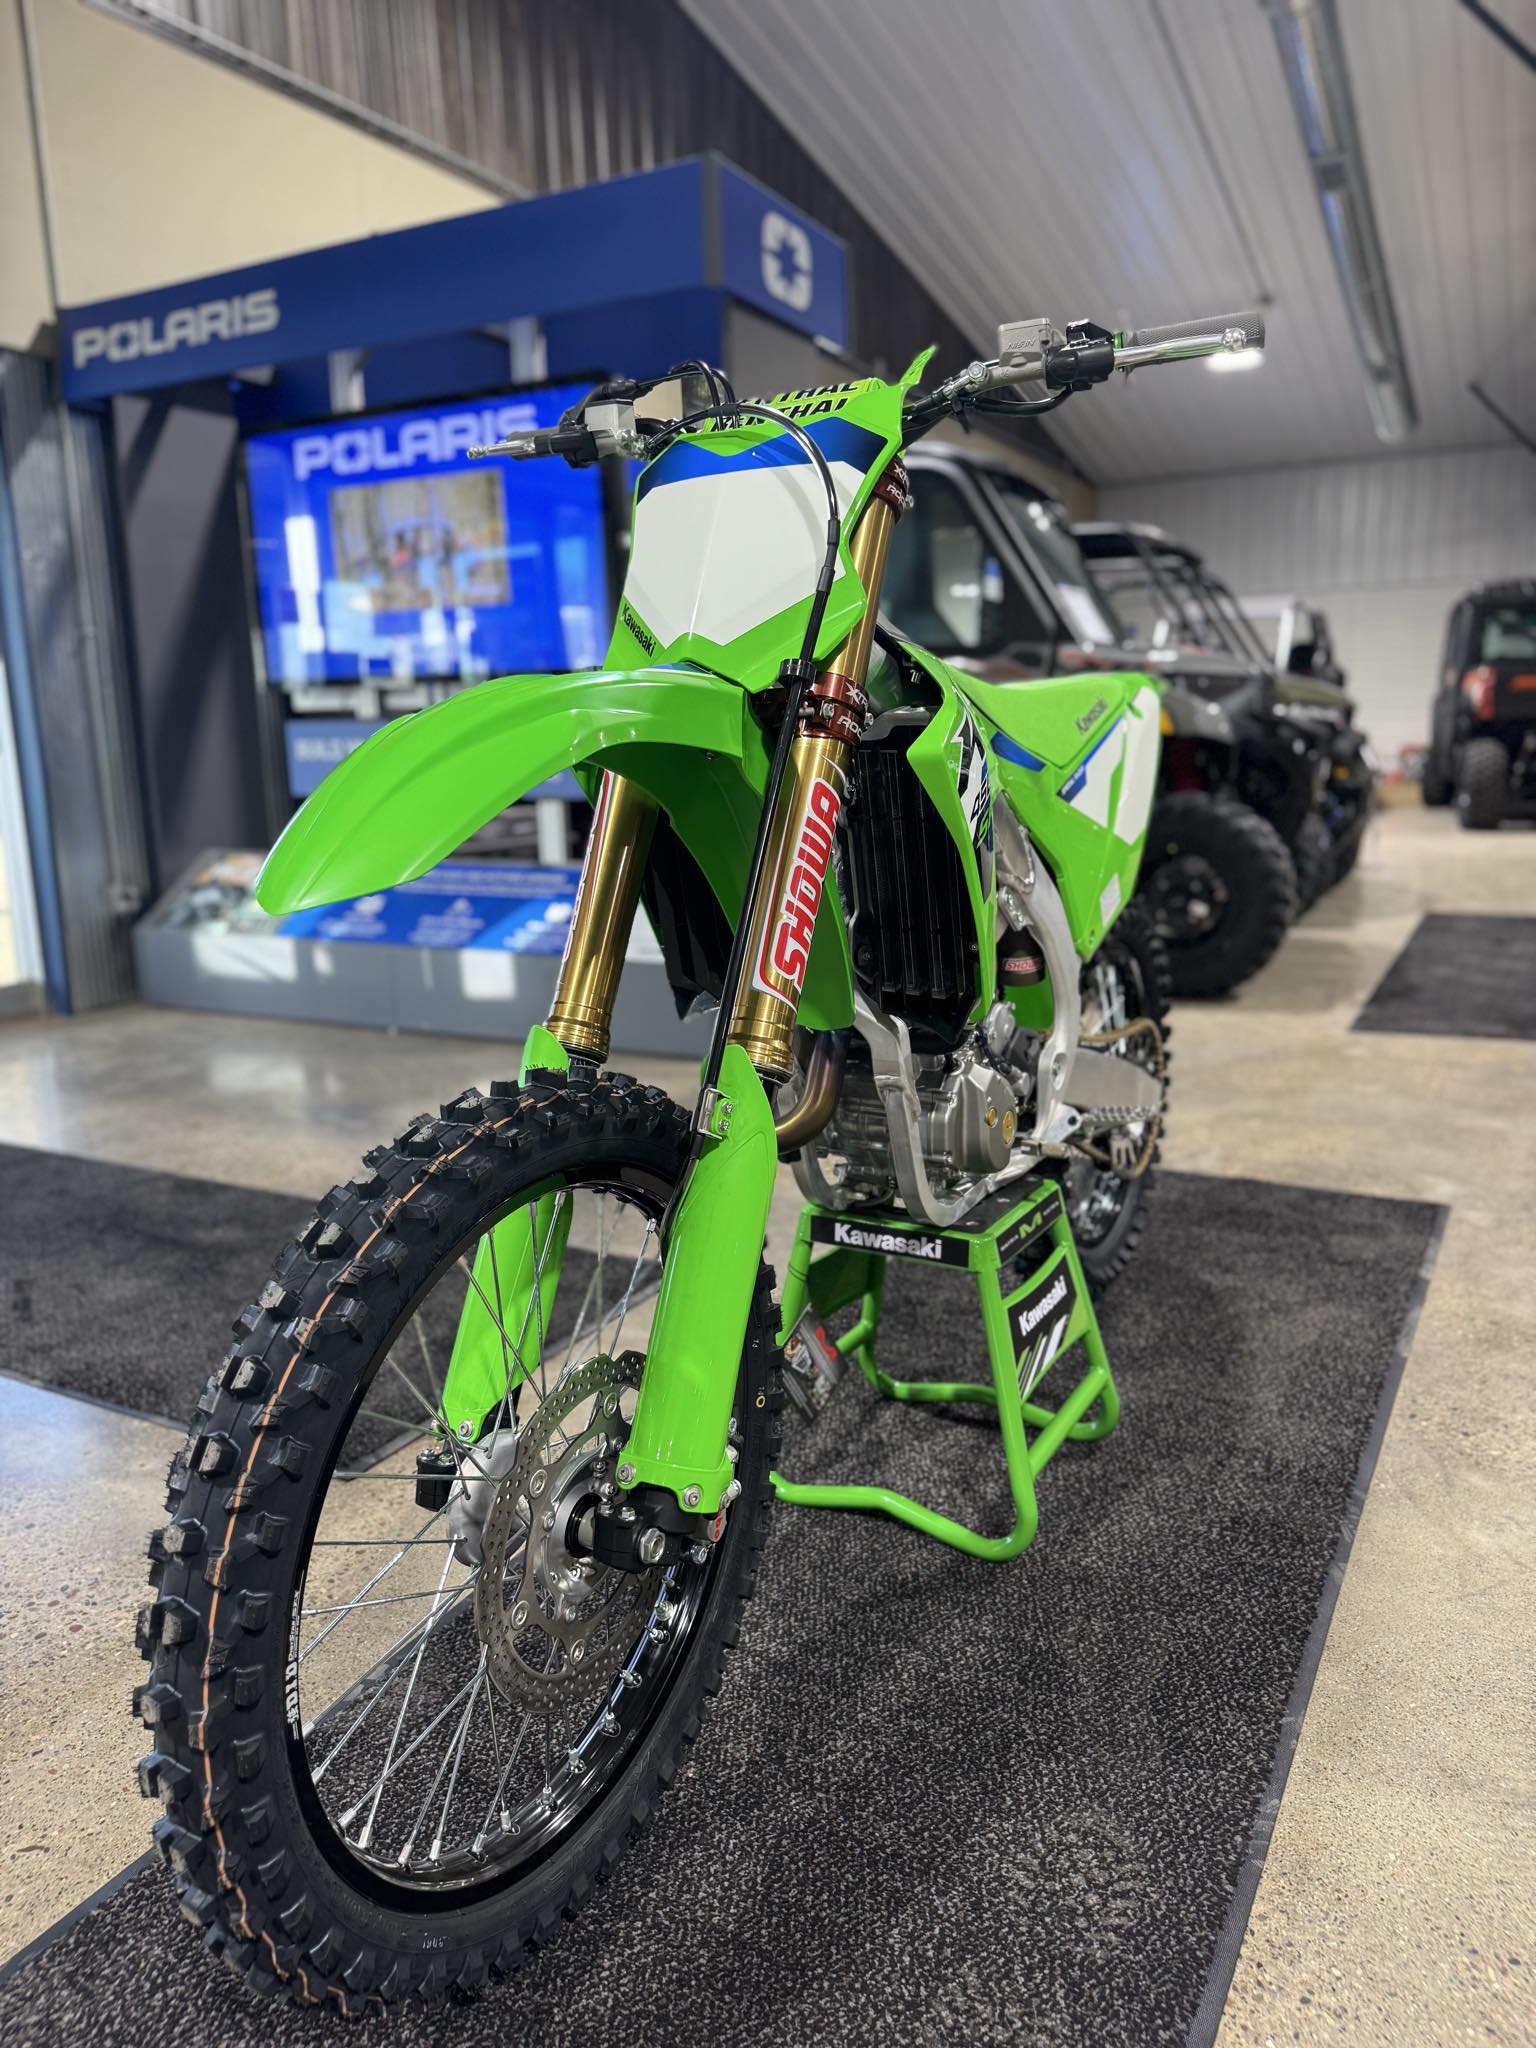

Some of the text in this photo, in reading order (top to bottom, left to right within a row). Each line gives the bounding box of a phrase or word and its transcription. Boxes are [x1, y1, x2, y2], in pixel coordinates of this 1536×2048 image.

[72, 288, 280, 369] POLARIS
[292, 403, 538, 481] POLARIS
[622, 603, 657, 658] Kawasaki
[775, 780, 840, 988] SHOWA
[834, 1222, 943, 1260] Kawasaki
[1018, 1275, 1068, 1337] Kawasaki
